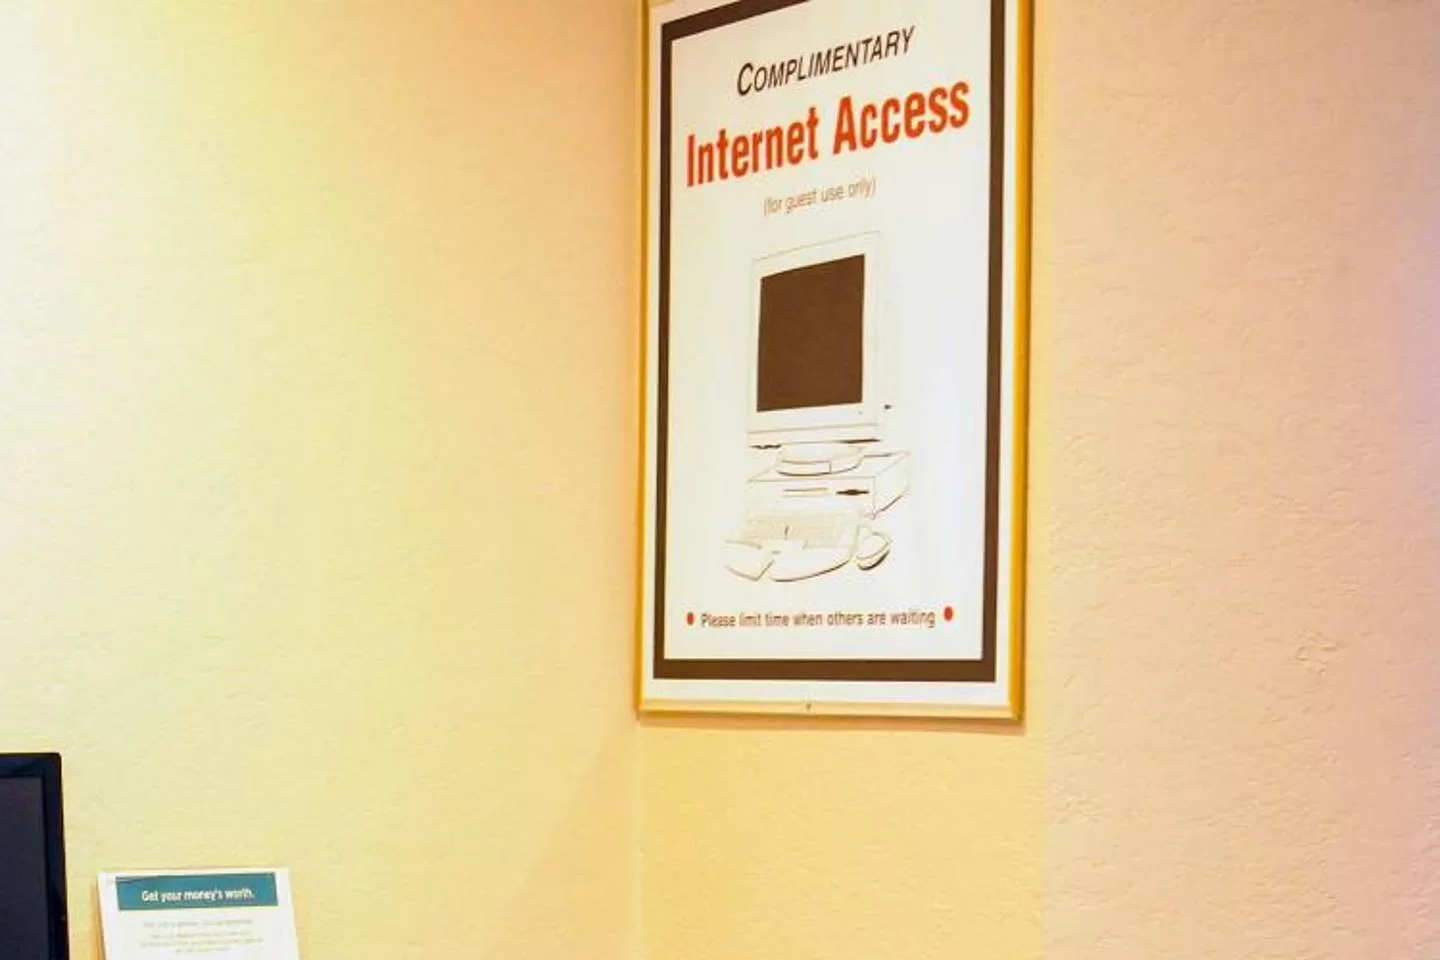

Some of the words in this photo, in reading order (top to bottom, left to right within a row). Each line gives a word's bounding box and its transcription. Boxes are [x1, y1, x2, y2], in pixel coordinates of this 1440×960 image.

[737, 25, 915, 96] COMPLIMENTARY
[686, 107, 820, 187] Internet
[832, 81, 970, 155] Access
[784, 187, 817, 214] guest
[820, 185, 844, 202] use
[700, 612, 735, 627] Please
[739, 611, 761, 627] limit
[765, 613, 789, 627] time
[792, 610, 823, 626] when
[827, 610, 864, 625] others
[867, 612, 886, 625] are
[890, 609, 936, 629] waiting
[141, 889, 158, 902] Get
[160, 890, 182, 903] your
[184, 887, 223, 901] money's
